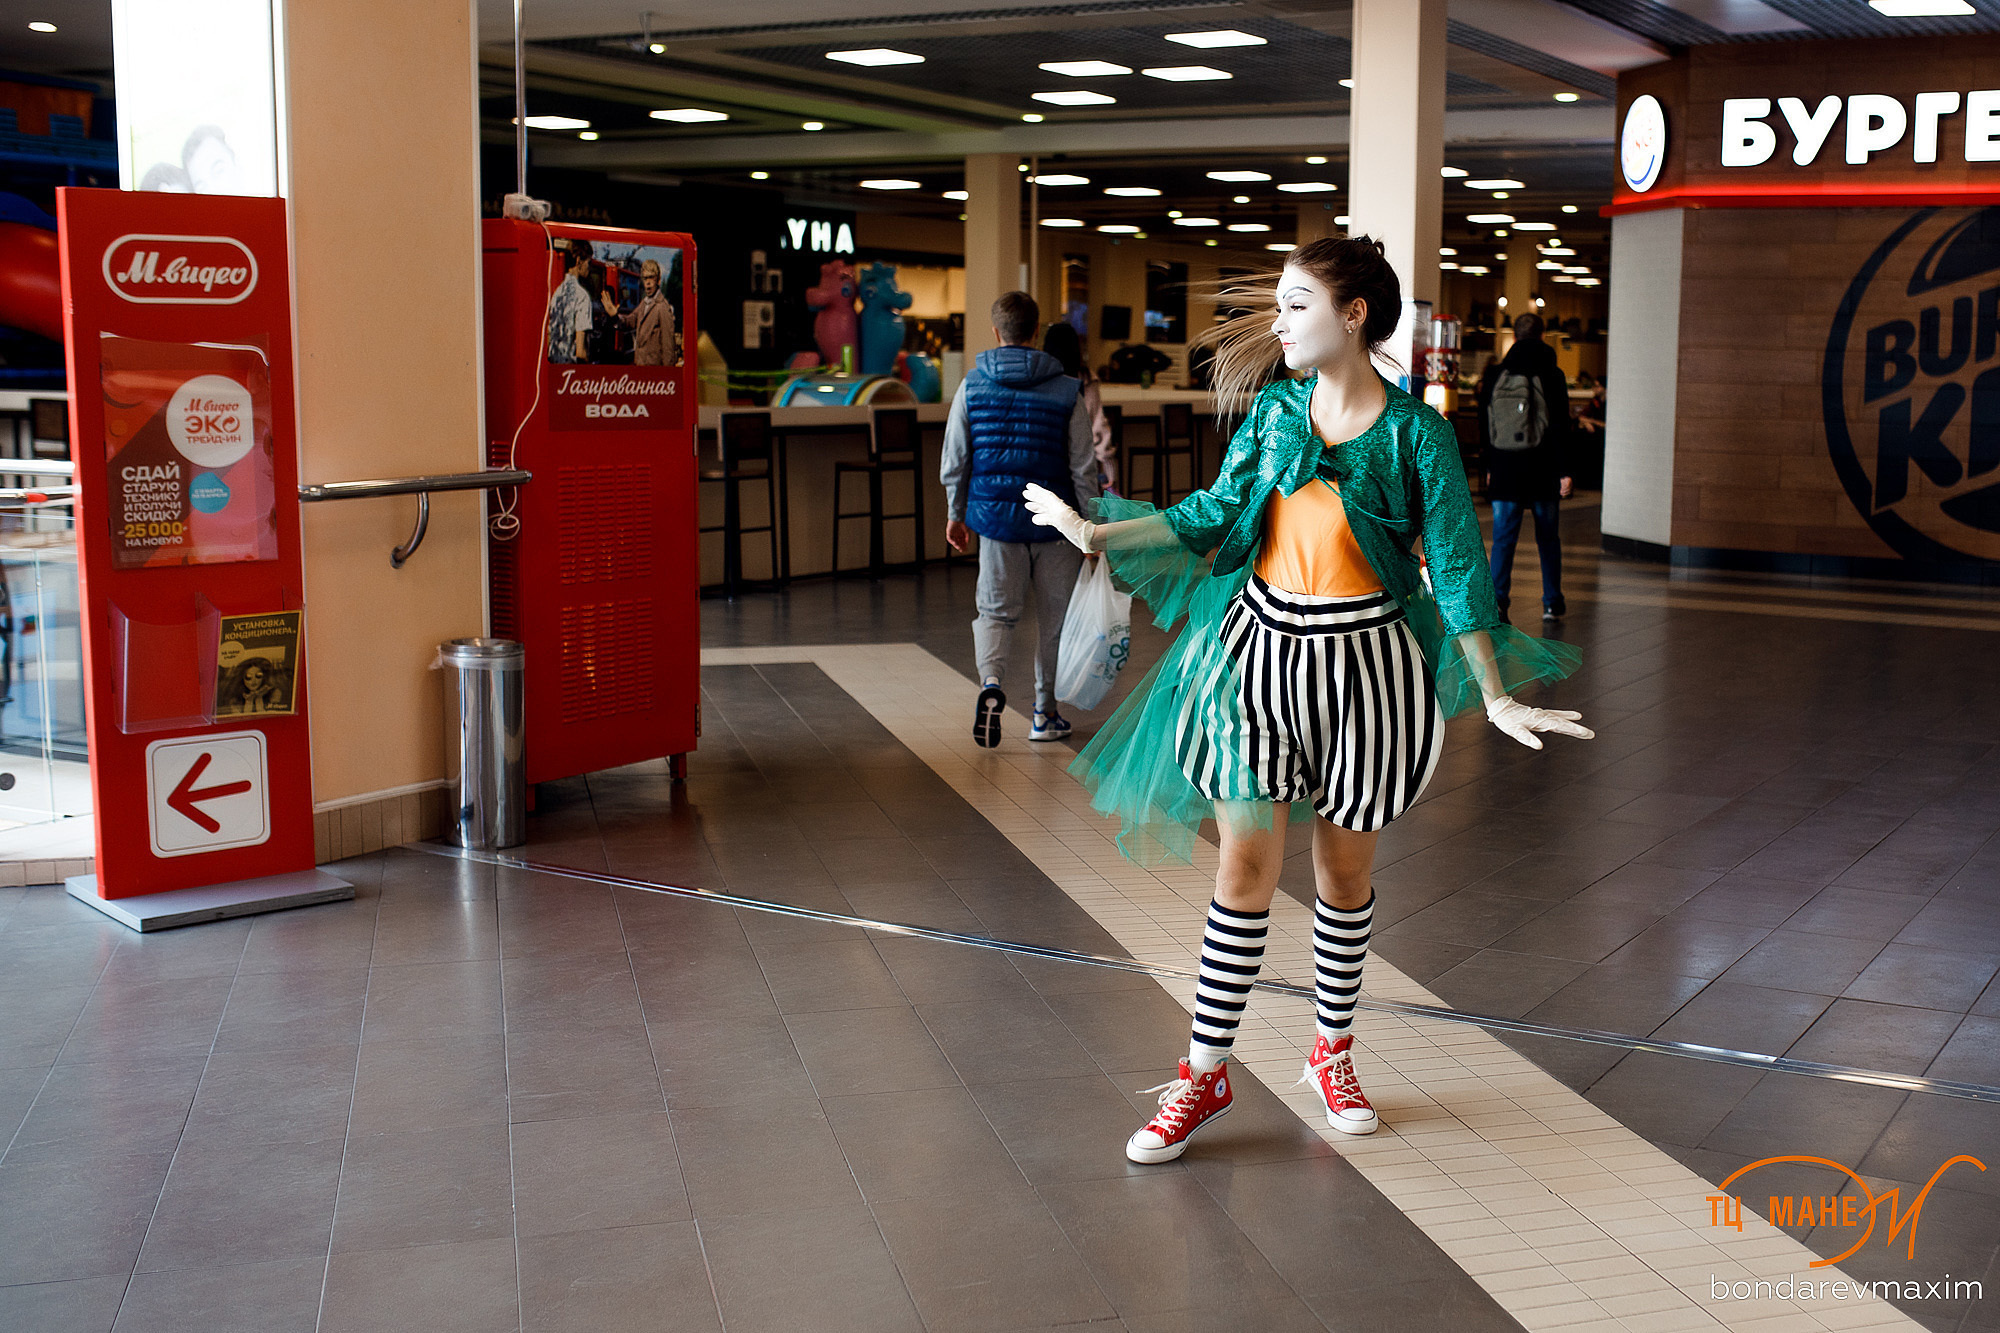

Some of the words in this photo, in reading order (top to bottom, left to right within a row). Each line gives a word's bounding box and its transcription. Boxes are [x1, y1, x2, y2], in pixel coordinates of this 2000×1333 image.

[1721, 89, 2000, 168] БУРГЕ
[780, 217, 855, 254] УНА
[116, 251, 248, 293] М.видео
[557, 369, 676, 403] Газированная
[585, 403, 650, 419] ВОДА
[121, 461, 181, 482] СДАЙ
[122, 480, 181, 494] СТАРУЮ
[122, 491, 180, 503] ТЕХНИКУ
[123, 503, 133, 512] И
[134, 501, 182, 512] ПОЛУЧИ
[123, 510, 181, 523] СКИДКУ
[125, 538, 142, 547] НА
[142, 535, 184, 547] НОВУЮ
[232, 618, 285, 632] УСТАНОВКА
